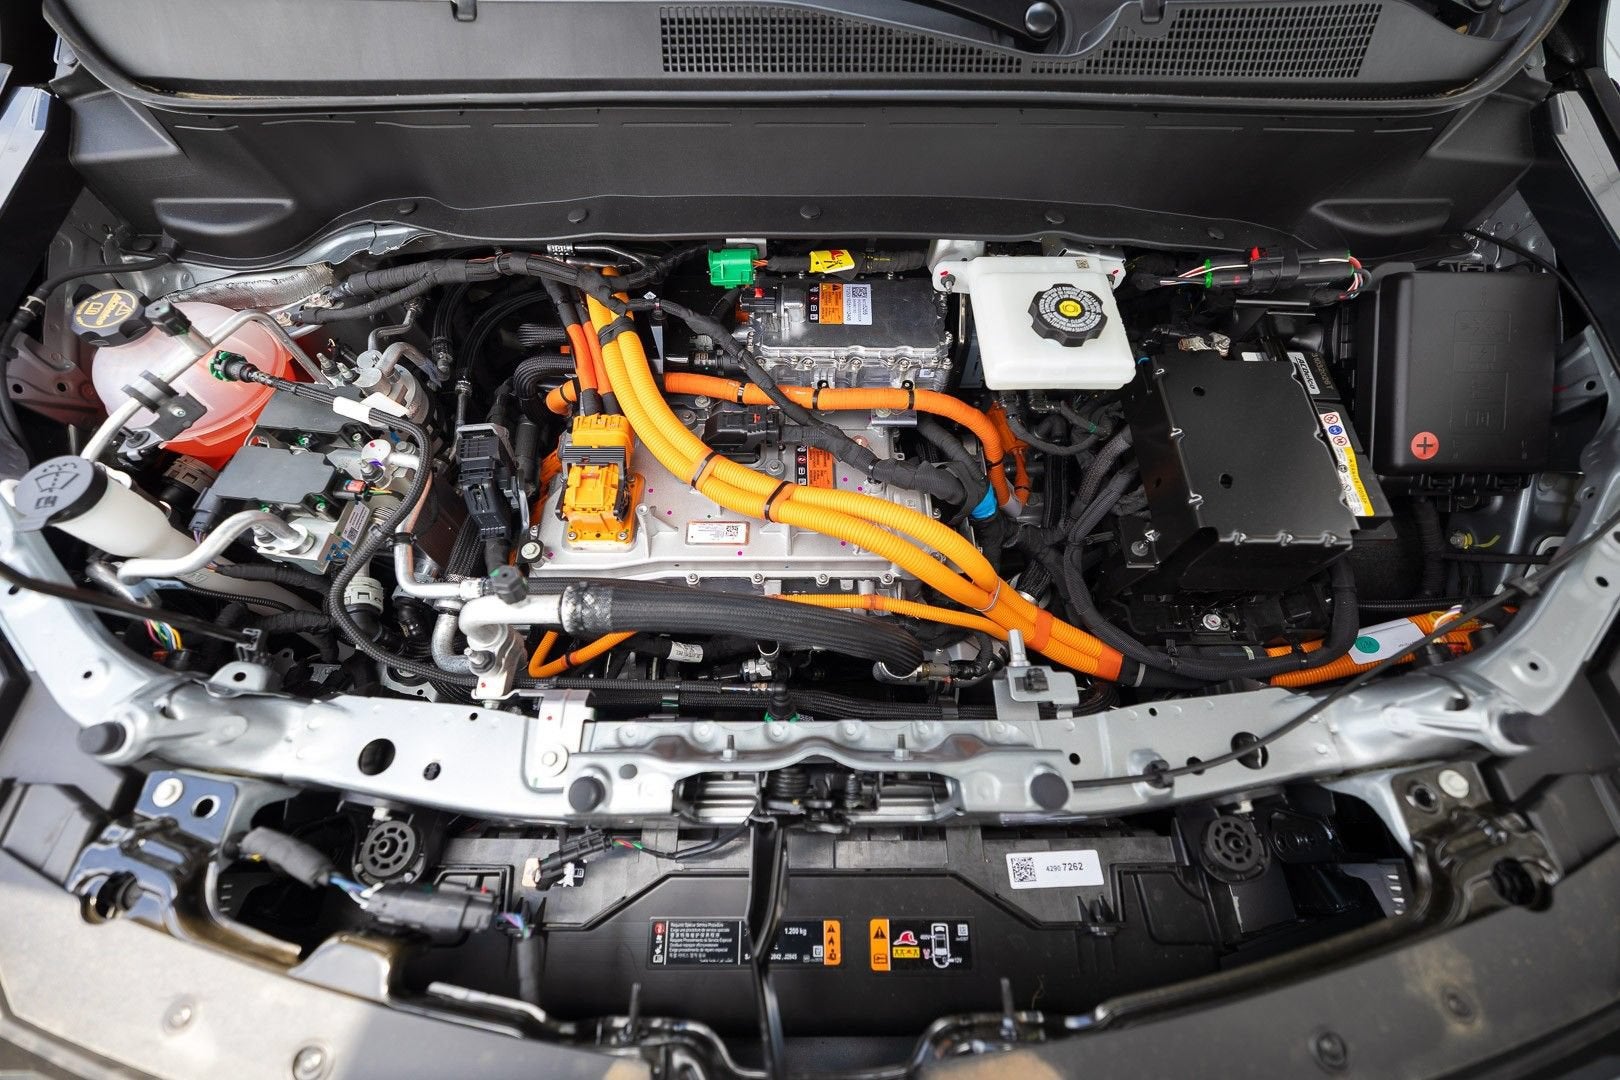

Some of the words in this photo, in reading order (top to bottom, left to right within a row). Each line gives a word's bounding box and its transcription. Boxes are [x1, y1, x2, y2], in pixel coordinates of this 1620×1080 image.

[1297, 358, 1316, 389] ACDelco
[1062, 862, 1083, 871] 7262
[800, 928, 807, 936] kg
